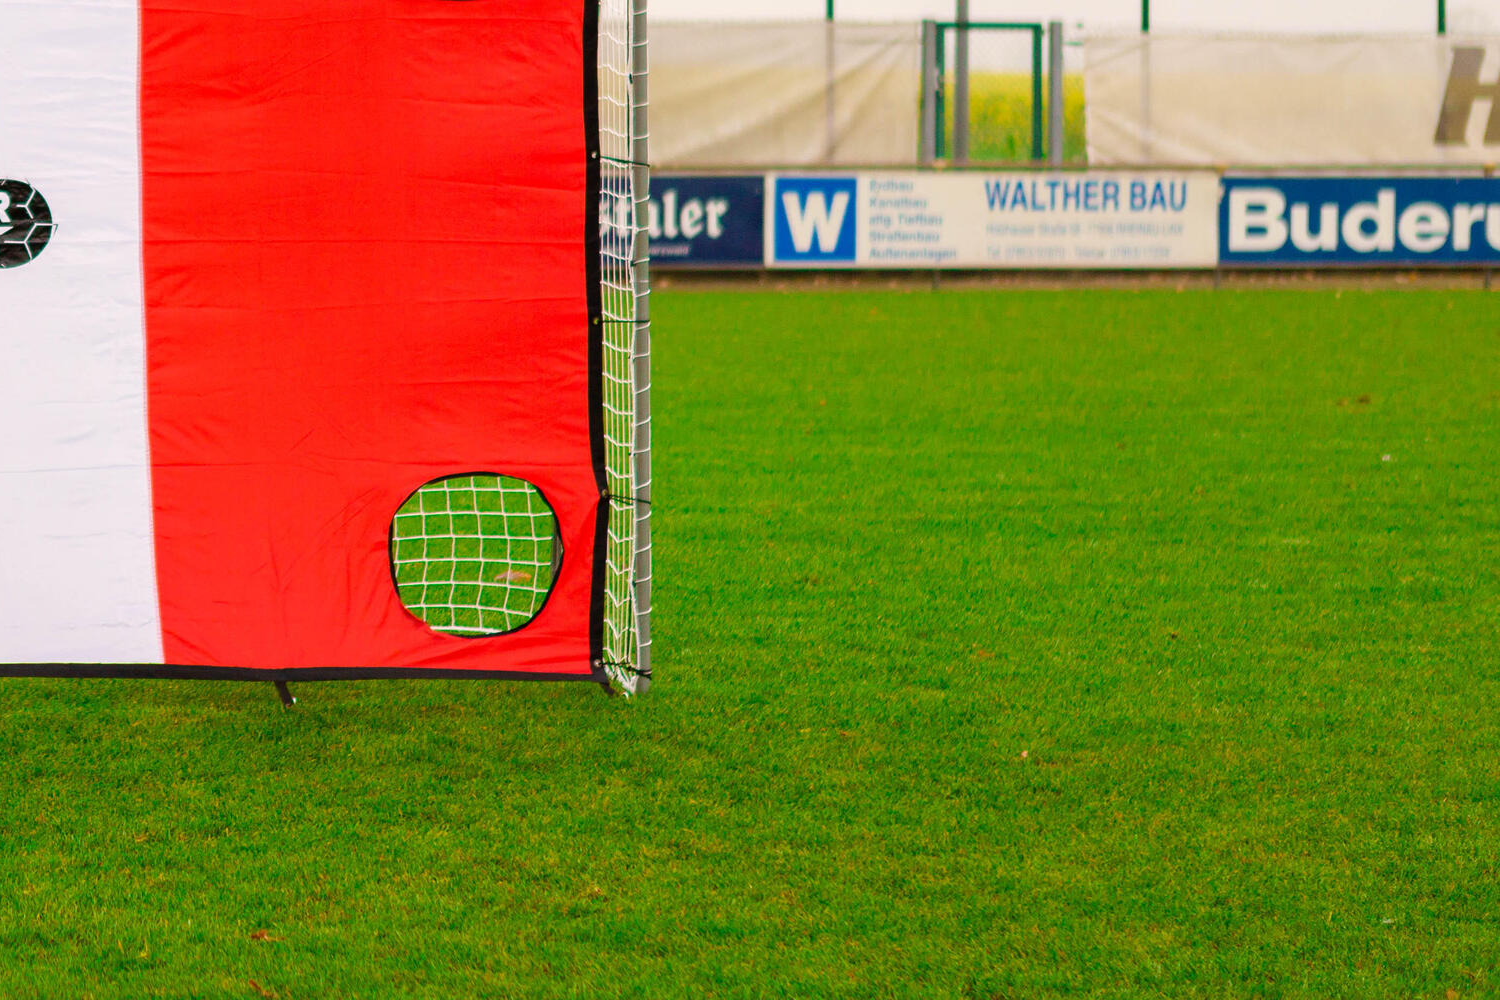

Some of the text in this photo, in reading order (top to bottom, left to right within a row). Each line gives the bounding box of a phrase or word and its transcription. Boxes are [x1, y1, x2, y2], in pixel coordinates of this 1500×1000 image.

[869, 197, 928, 209] Kanalbau
[985, 180, 1188, 212] WALTHER BAU
[782, 191, 850, 253] W
